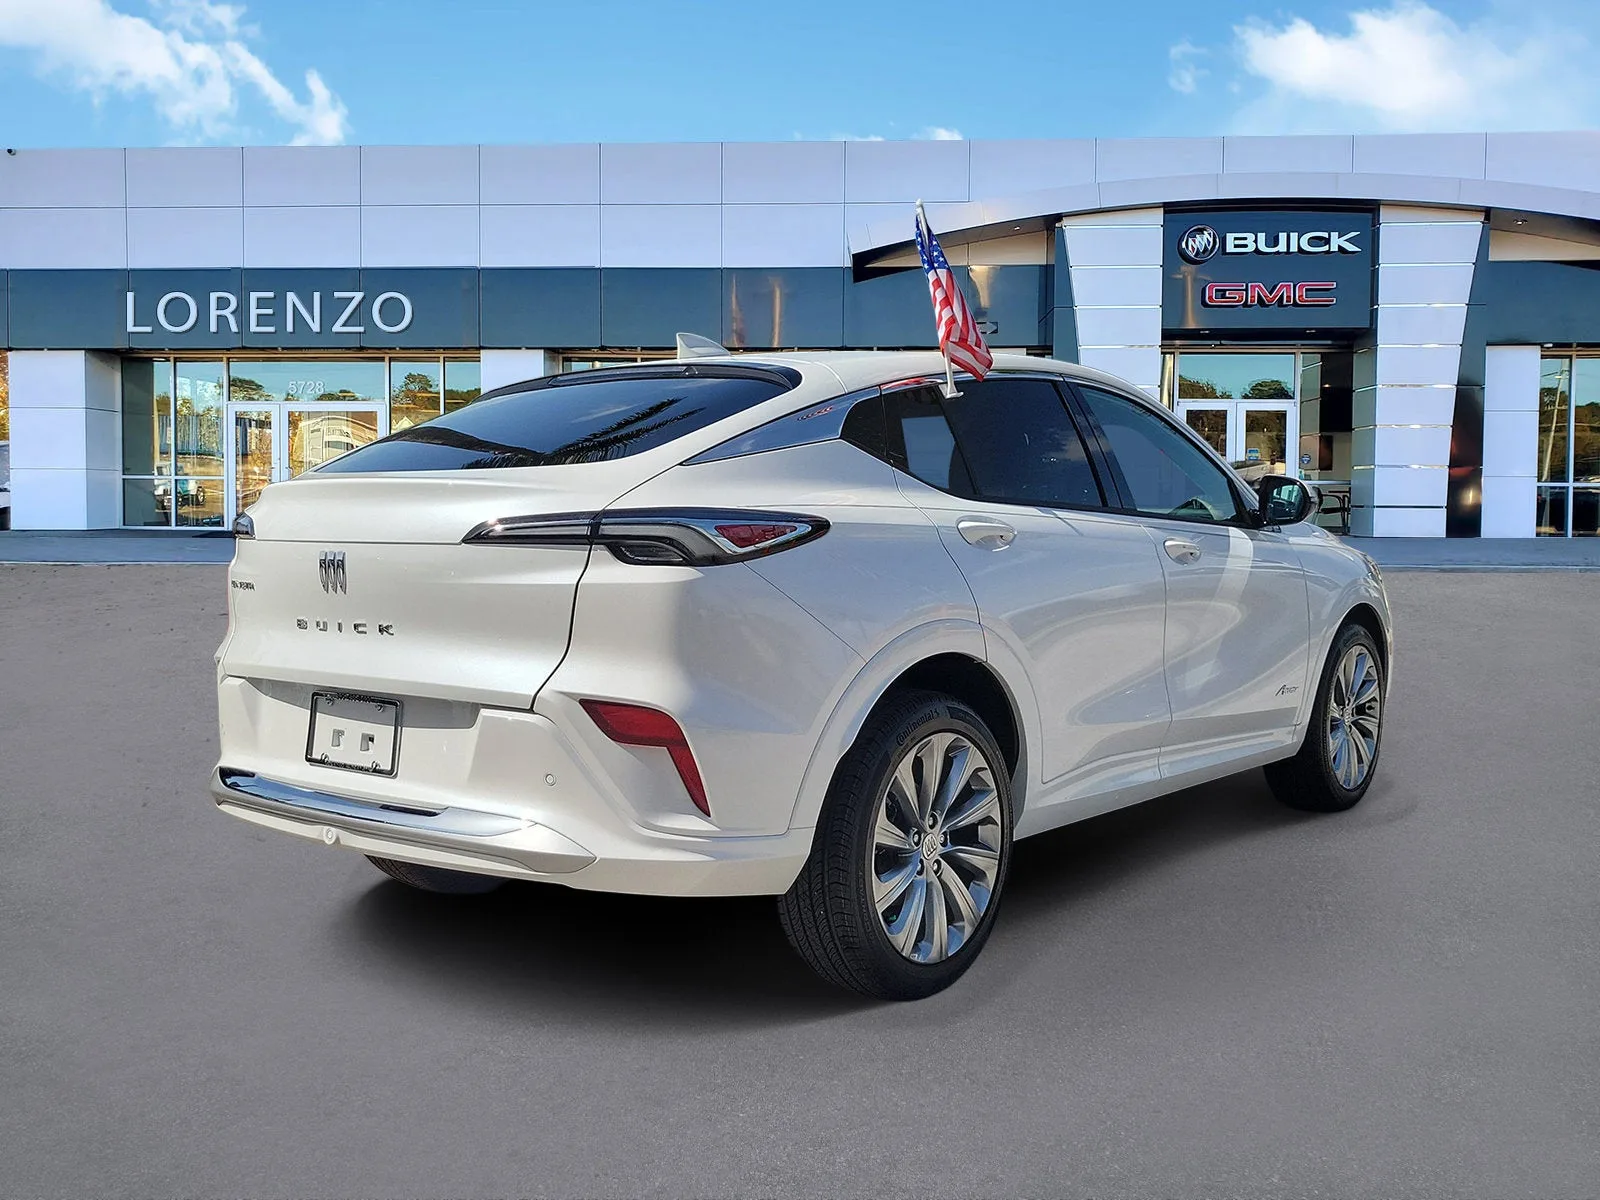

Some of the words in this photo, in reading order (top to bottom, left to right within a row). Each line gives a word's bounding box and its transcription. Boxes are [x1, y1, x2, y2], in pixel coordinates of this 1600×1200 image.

[1225, 231, 1362, 253] BUICK
[1205, 281, 1337, 306] GMC
[126, 291, 414, 333] LORENZO
[288, 380, 325, 395] 5728
[296, 618, 395, 636] BUICK
[896, 708, 936, 746] Continental
